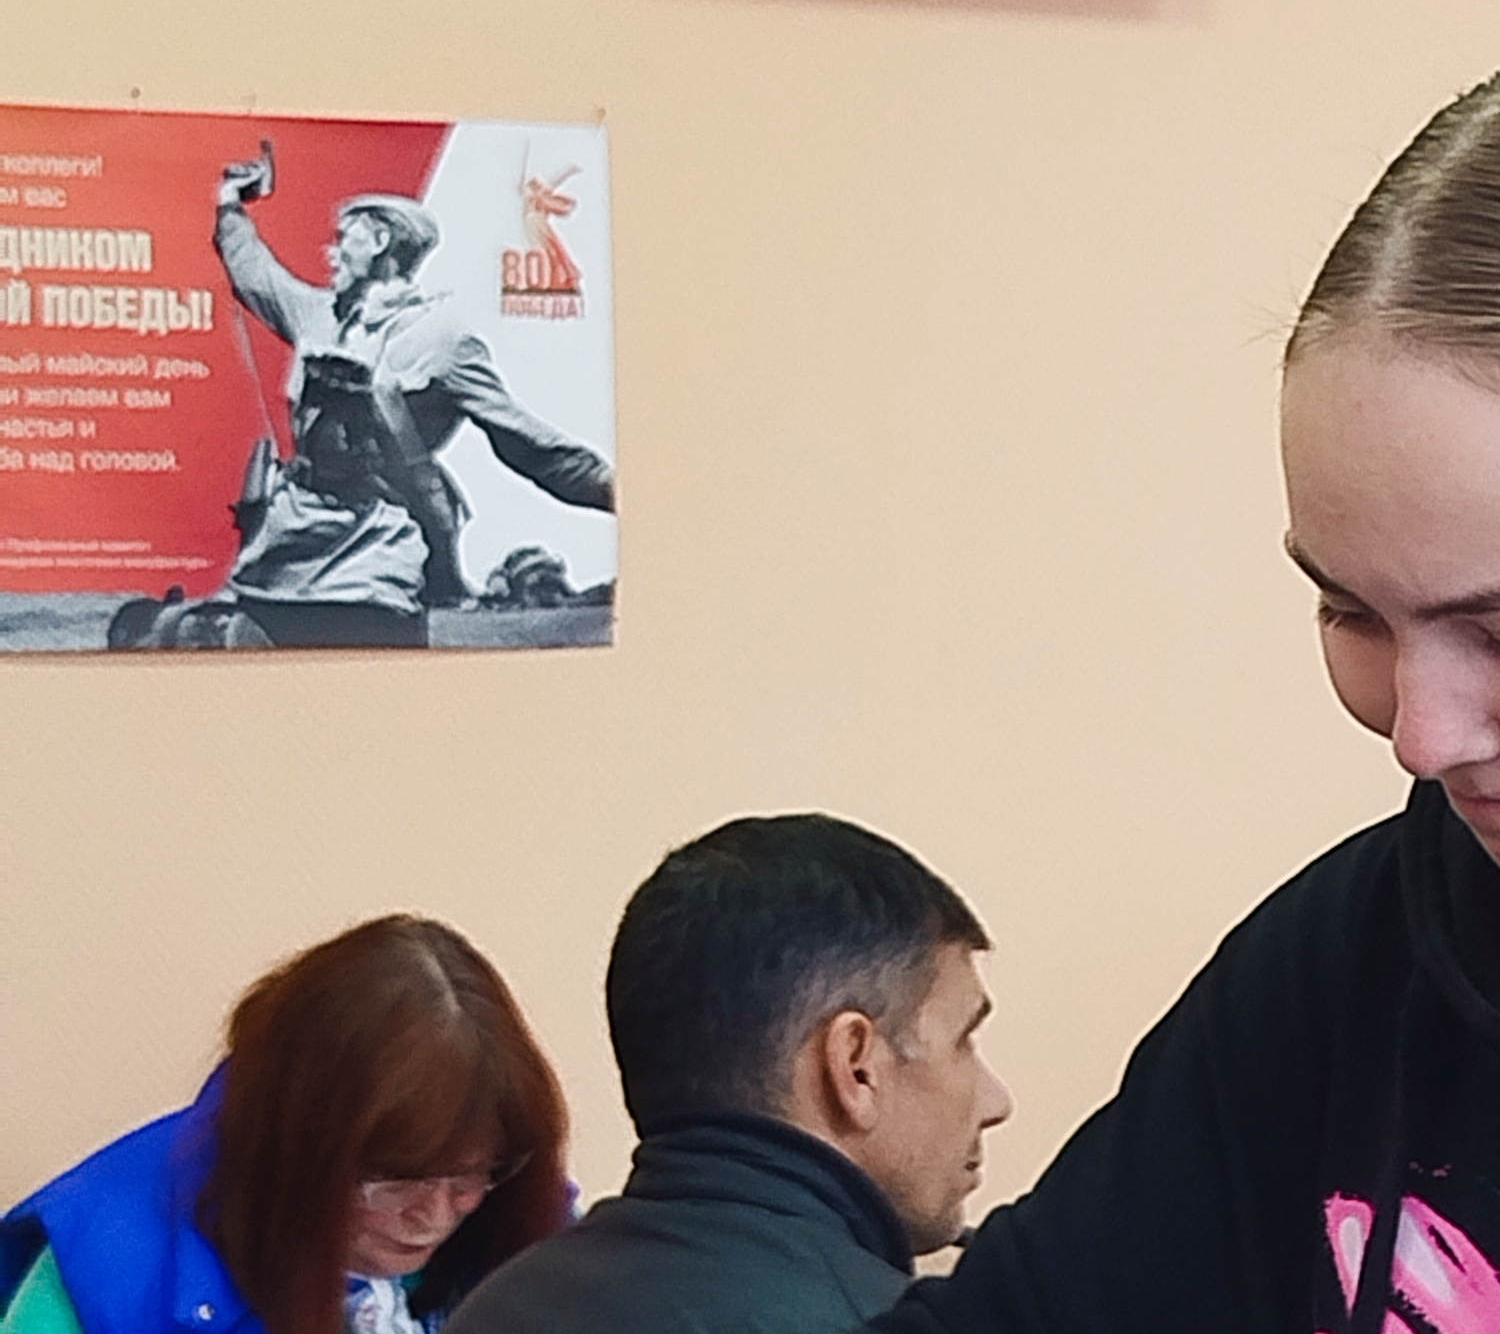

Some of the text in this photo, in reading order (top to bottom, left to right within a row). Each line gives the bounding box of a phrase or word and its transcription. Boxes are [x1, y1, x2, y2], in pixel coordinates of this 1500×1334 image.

[0, 228, 152, 275] ДНИКОМ
[0, 278, 214, 335] Й ПОБЕДЫ!
[46, 353, 148, 376] майский
[153, 358, 211, 380] день
[123, 390, 172, 409] вам
[78, 420, 96, 438] и
